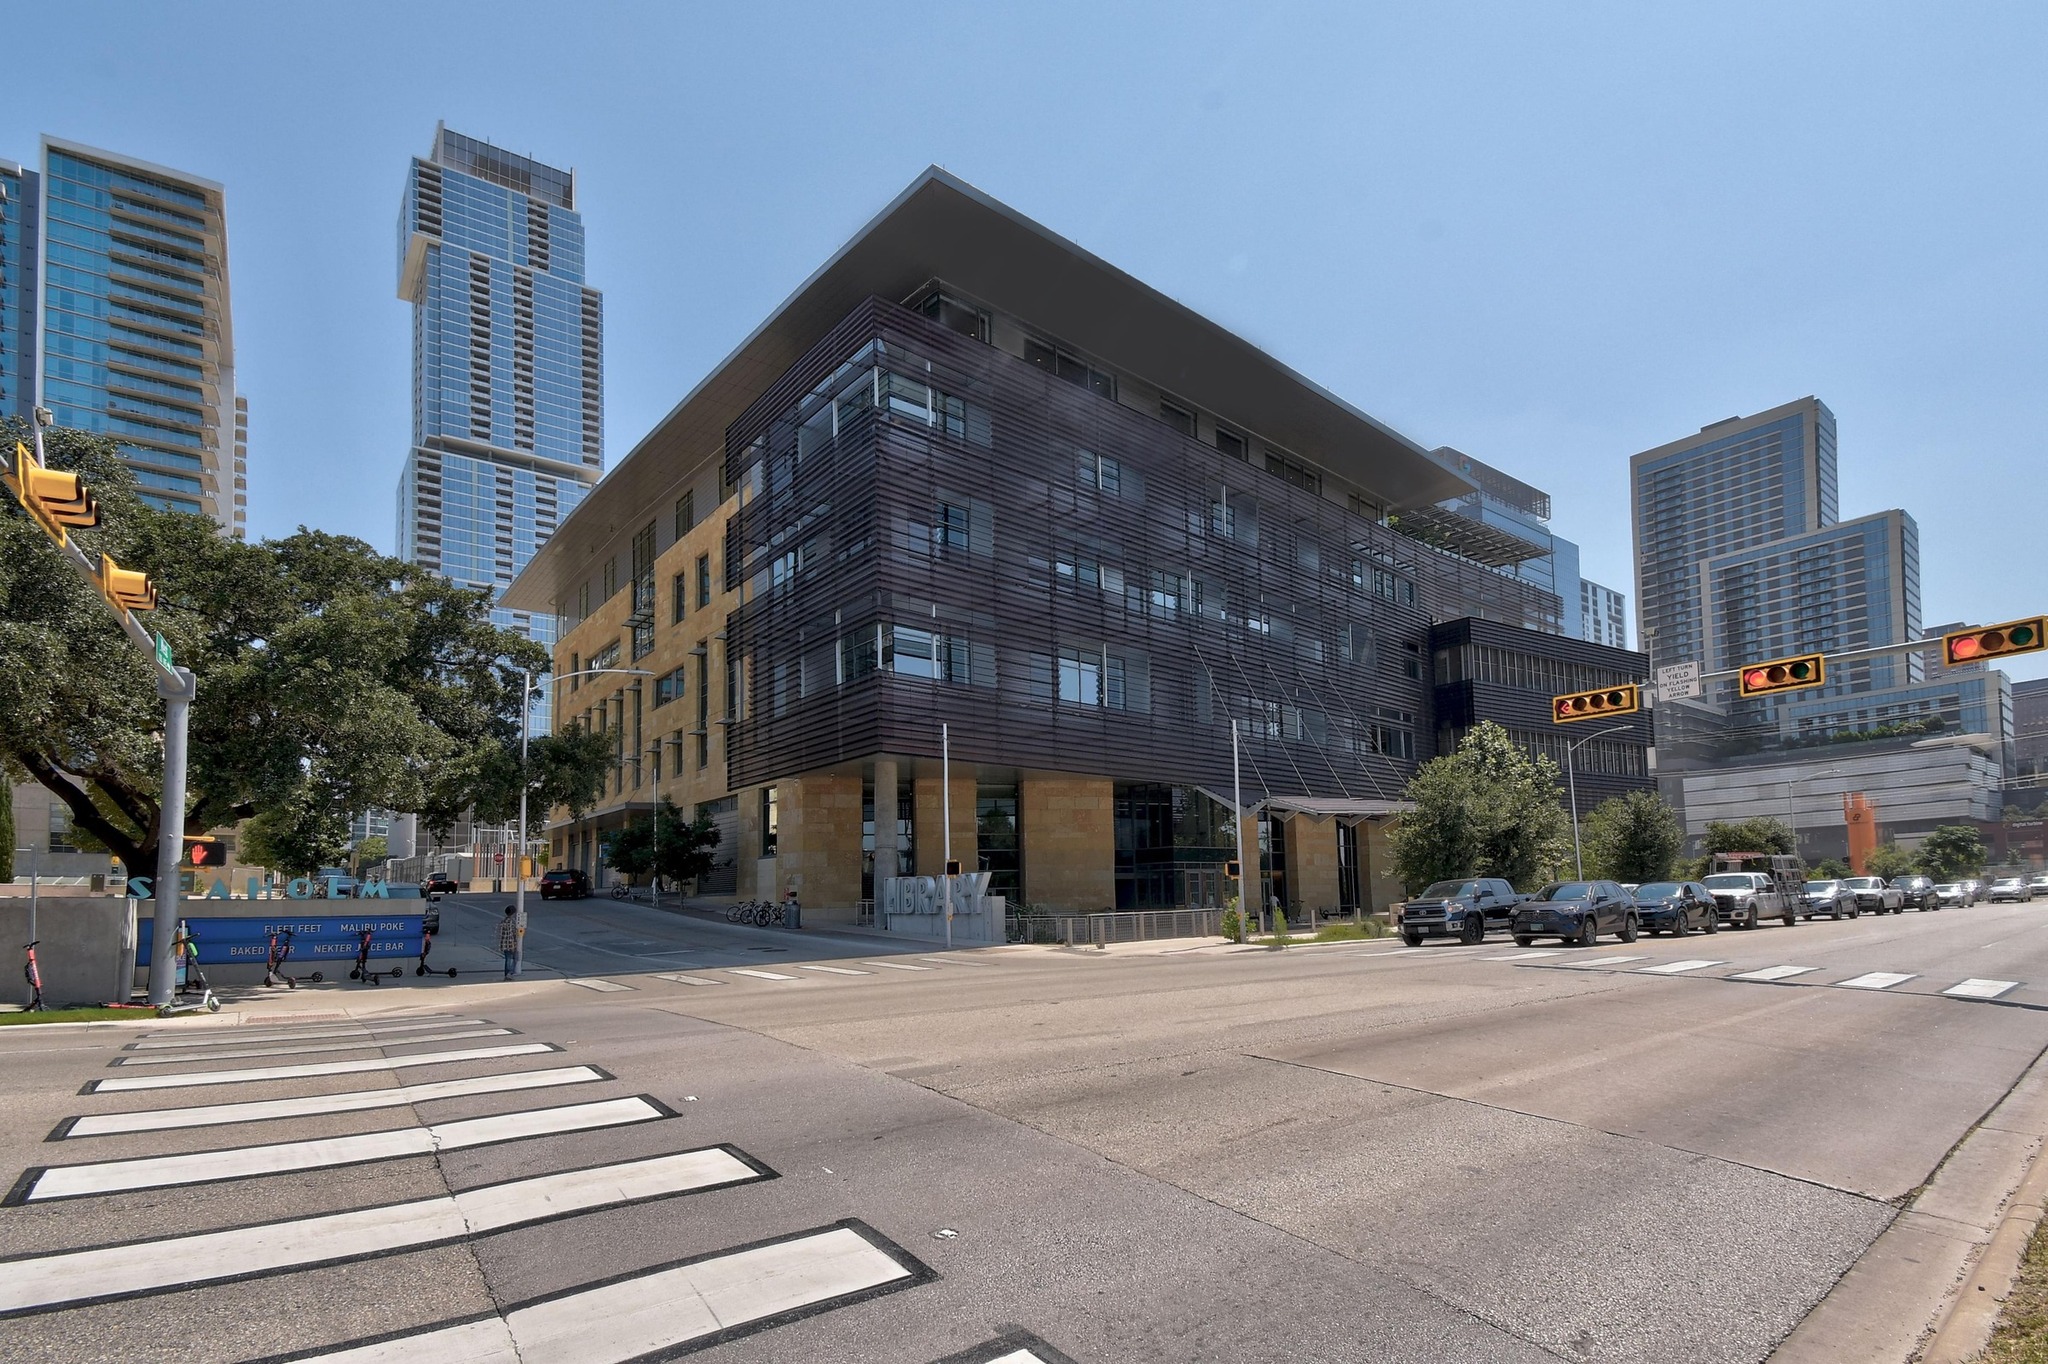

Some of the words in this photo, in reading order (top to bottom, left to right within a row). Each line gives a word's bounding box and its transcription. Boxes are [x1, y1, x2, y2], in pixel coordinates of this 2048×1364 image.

[1662, 666, 1676, 674] LEFT
[1667, 671, 1689, 680] YIELD
[1669, 677, 1697, 686] FLASHING
[884, 872, 992, 914] LIBRARY
[264, 925, 295, 934] FLEET
[298, 924, 322, 933] FEET
[340, 923, 377, 932] MALIBU
[380, 922, 405, 931] POKE
[230, 946, 265, 956] BAKED
[314, 944, 352, 953] NEKTER
[355, 943, 382, 951] JCE
[385, 942, 404, 951] BAR
